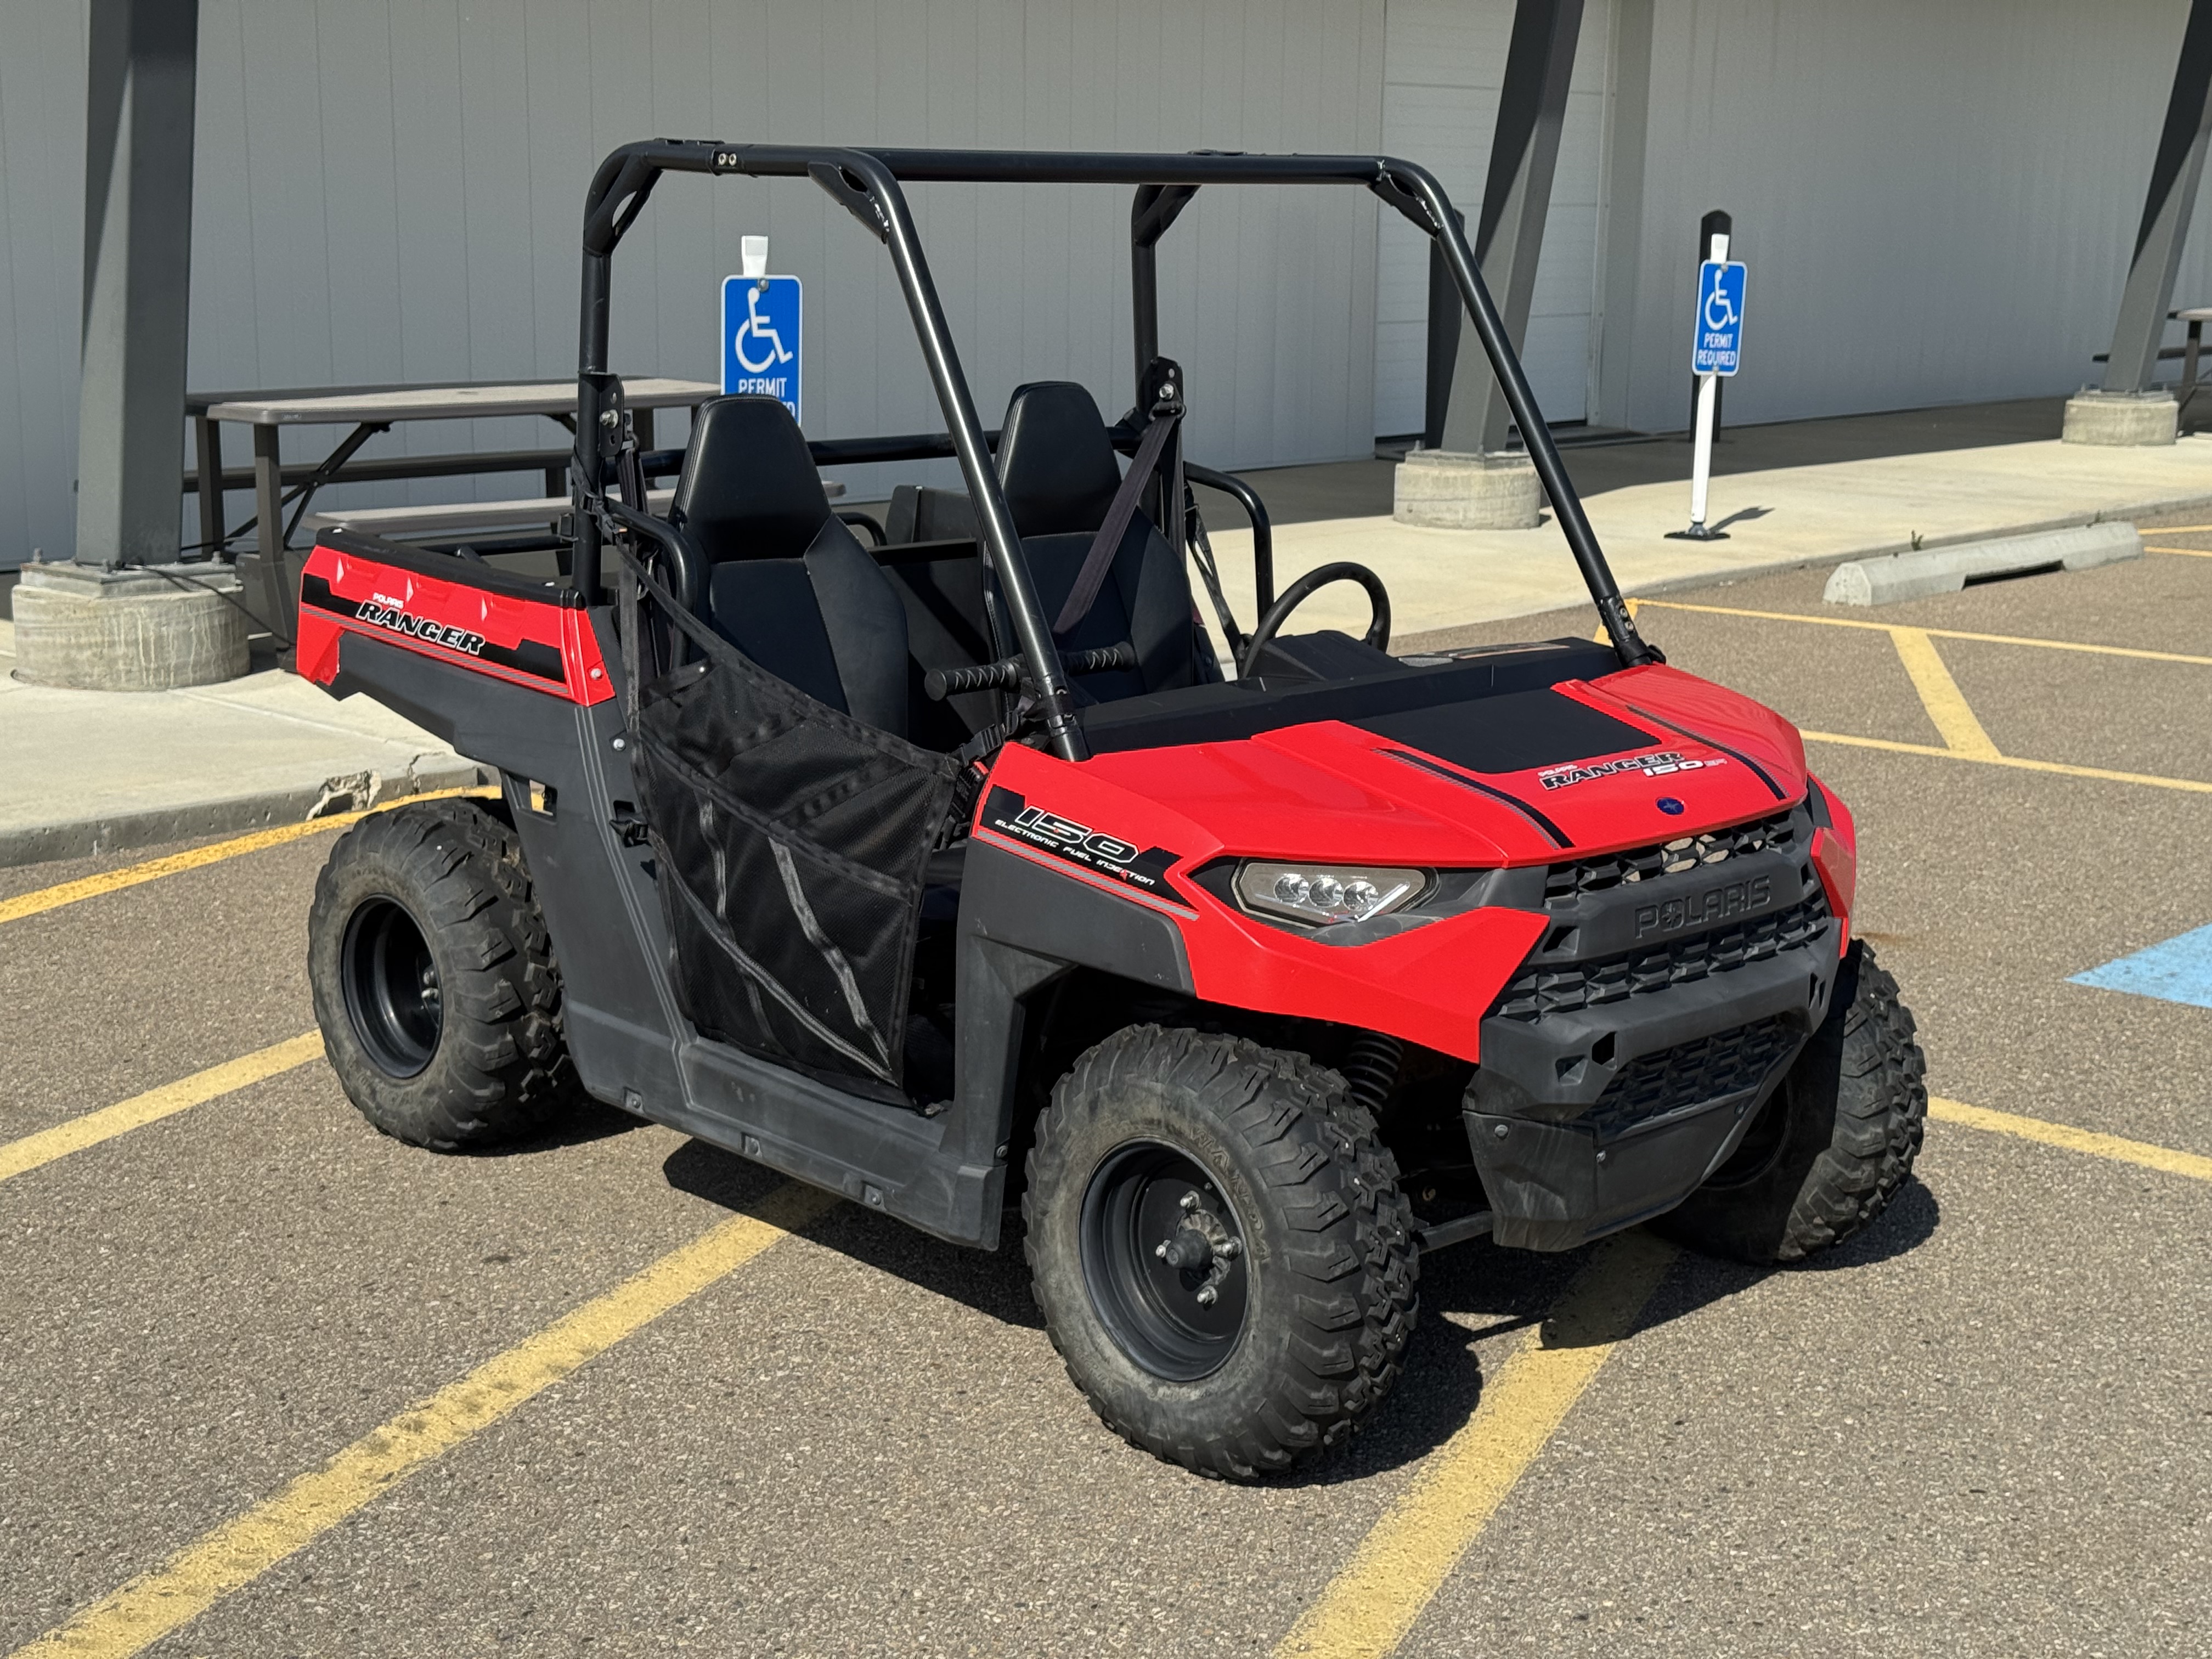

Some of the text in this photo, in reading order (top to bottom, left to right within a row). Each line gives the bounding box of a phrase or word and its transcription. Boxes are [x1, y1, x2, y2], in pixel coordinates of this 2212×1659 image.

[1703, 332, 1733, 348] PERMIT
[1697, 349, 1736, 366] REQUIRED
[738, 377, 787, 398] PERMIT
[372, 592, 404, 610] POLARIS
[356, 599, 486, 656] RANGER
[1539, 751, 1685, 791] RANGER
[1643, 759, 1703, 777] 150
[995, 819, 1059, 848] ELECTRONIC
[1063, 846, 1092, 862] FUEL
[1014, 805, 1139, 864] 150
[1635, 874, 1771, 939] POLARIS
